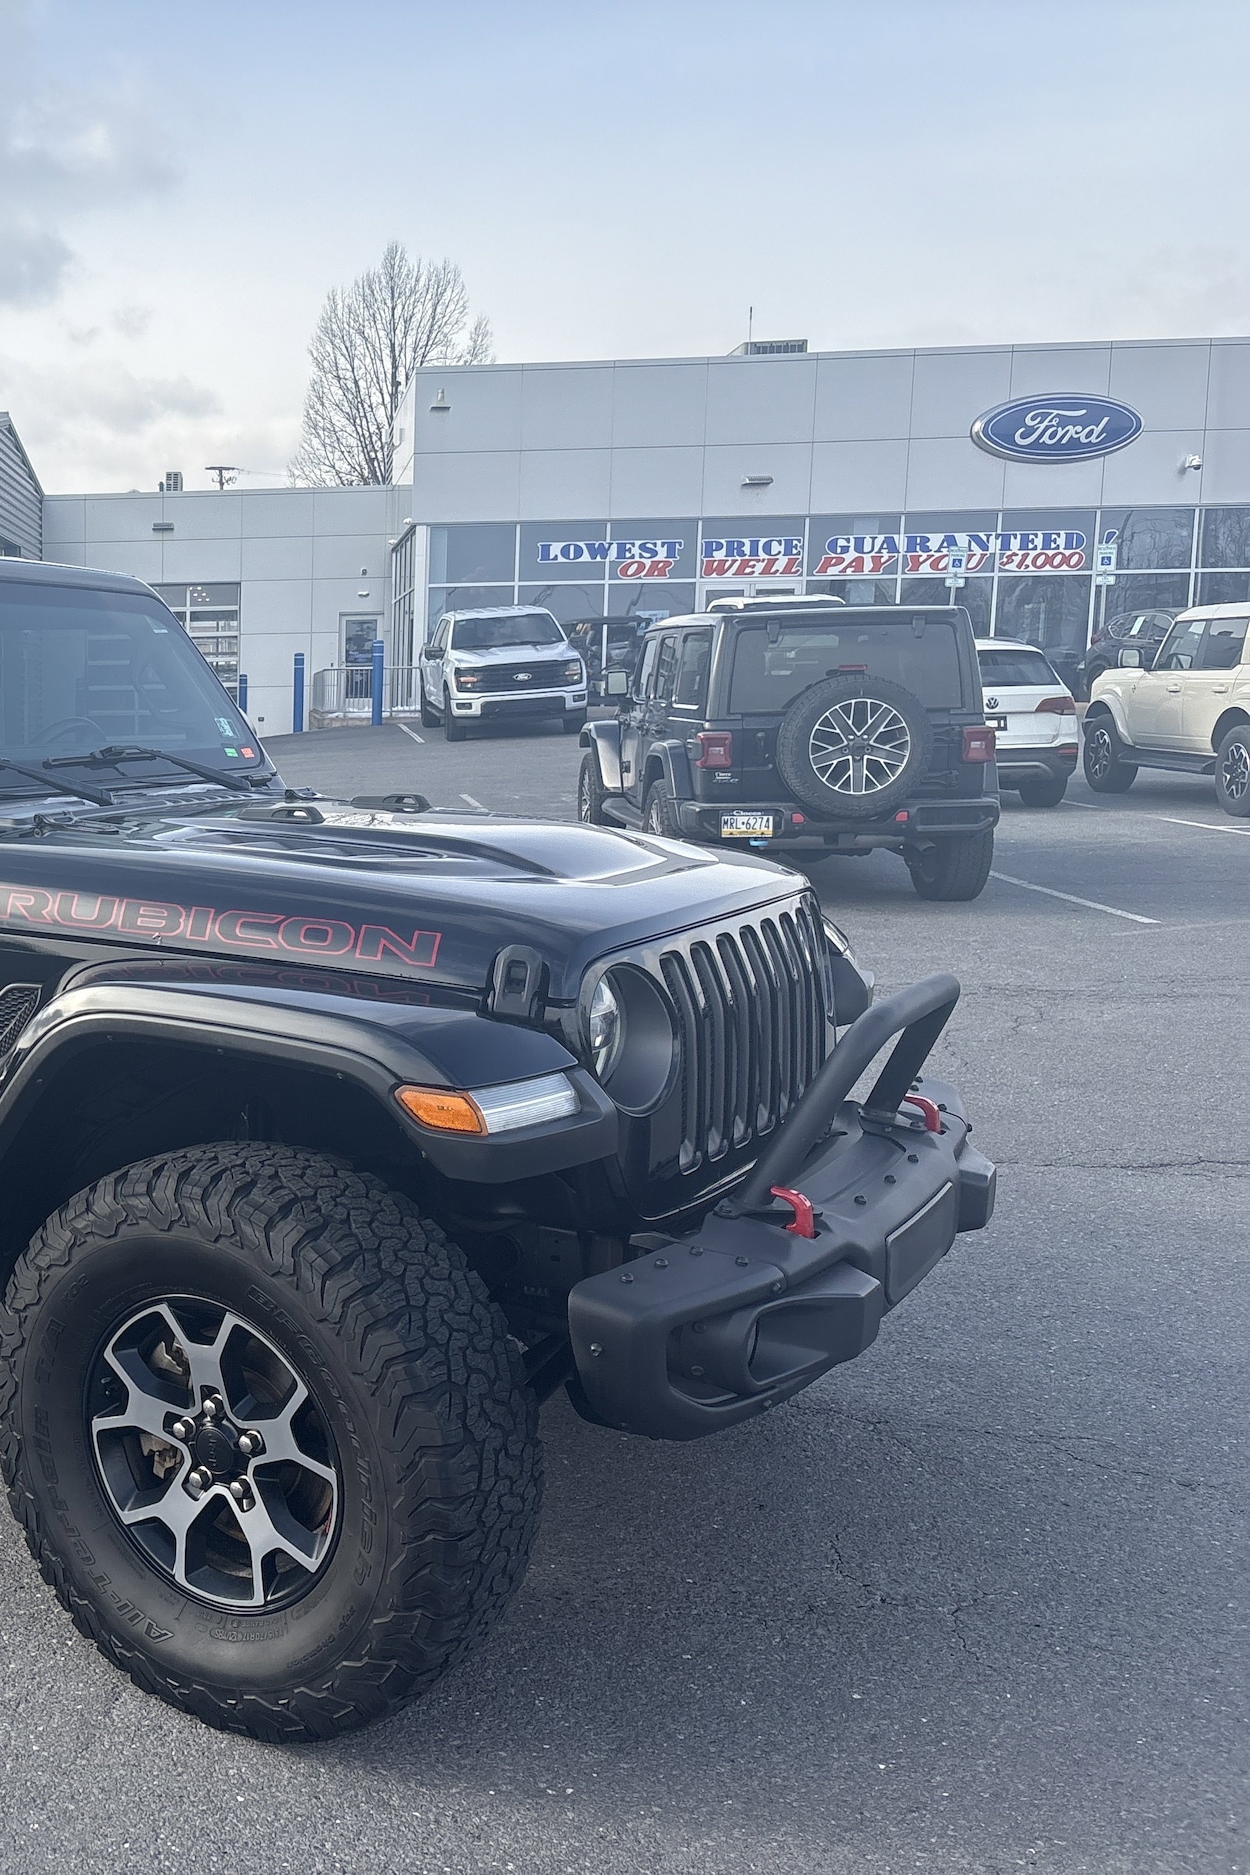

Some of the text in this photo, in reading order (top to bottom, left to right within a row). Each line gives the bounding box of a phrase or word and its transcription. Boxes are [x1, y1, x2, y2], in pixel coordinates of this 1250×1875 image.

[1014, 408, 1111, 446] Ford
[538, 540, 684, 562] LOWEST
[701, 538, 802, 558] PRICE
[826, 531, 1086, 554] GUARANTEED
[618, 550, 1086, 578] OR WE'LL PAY YOU $1,000
[246, 1283, 379, 1587] BFGoodrich
[31, 1404, 176, 1644] All-Terrain
